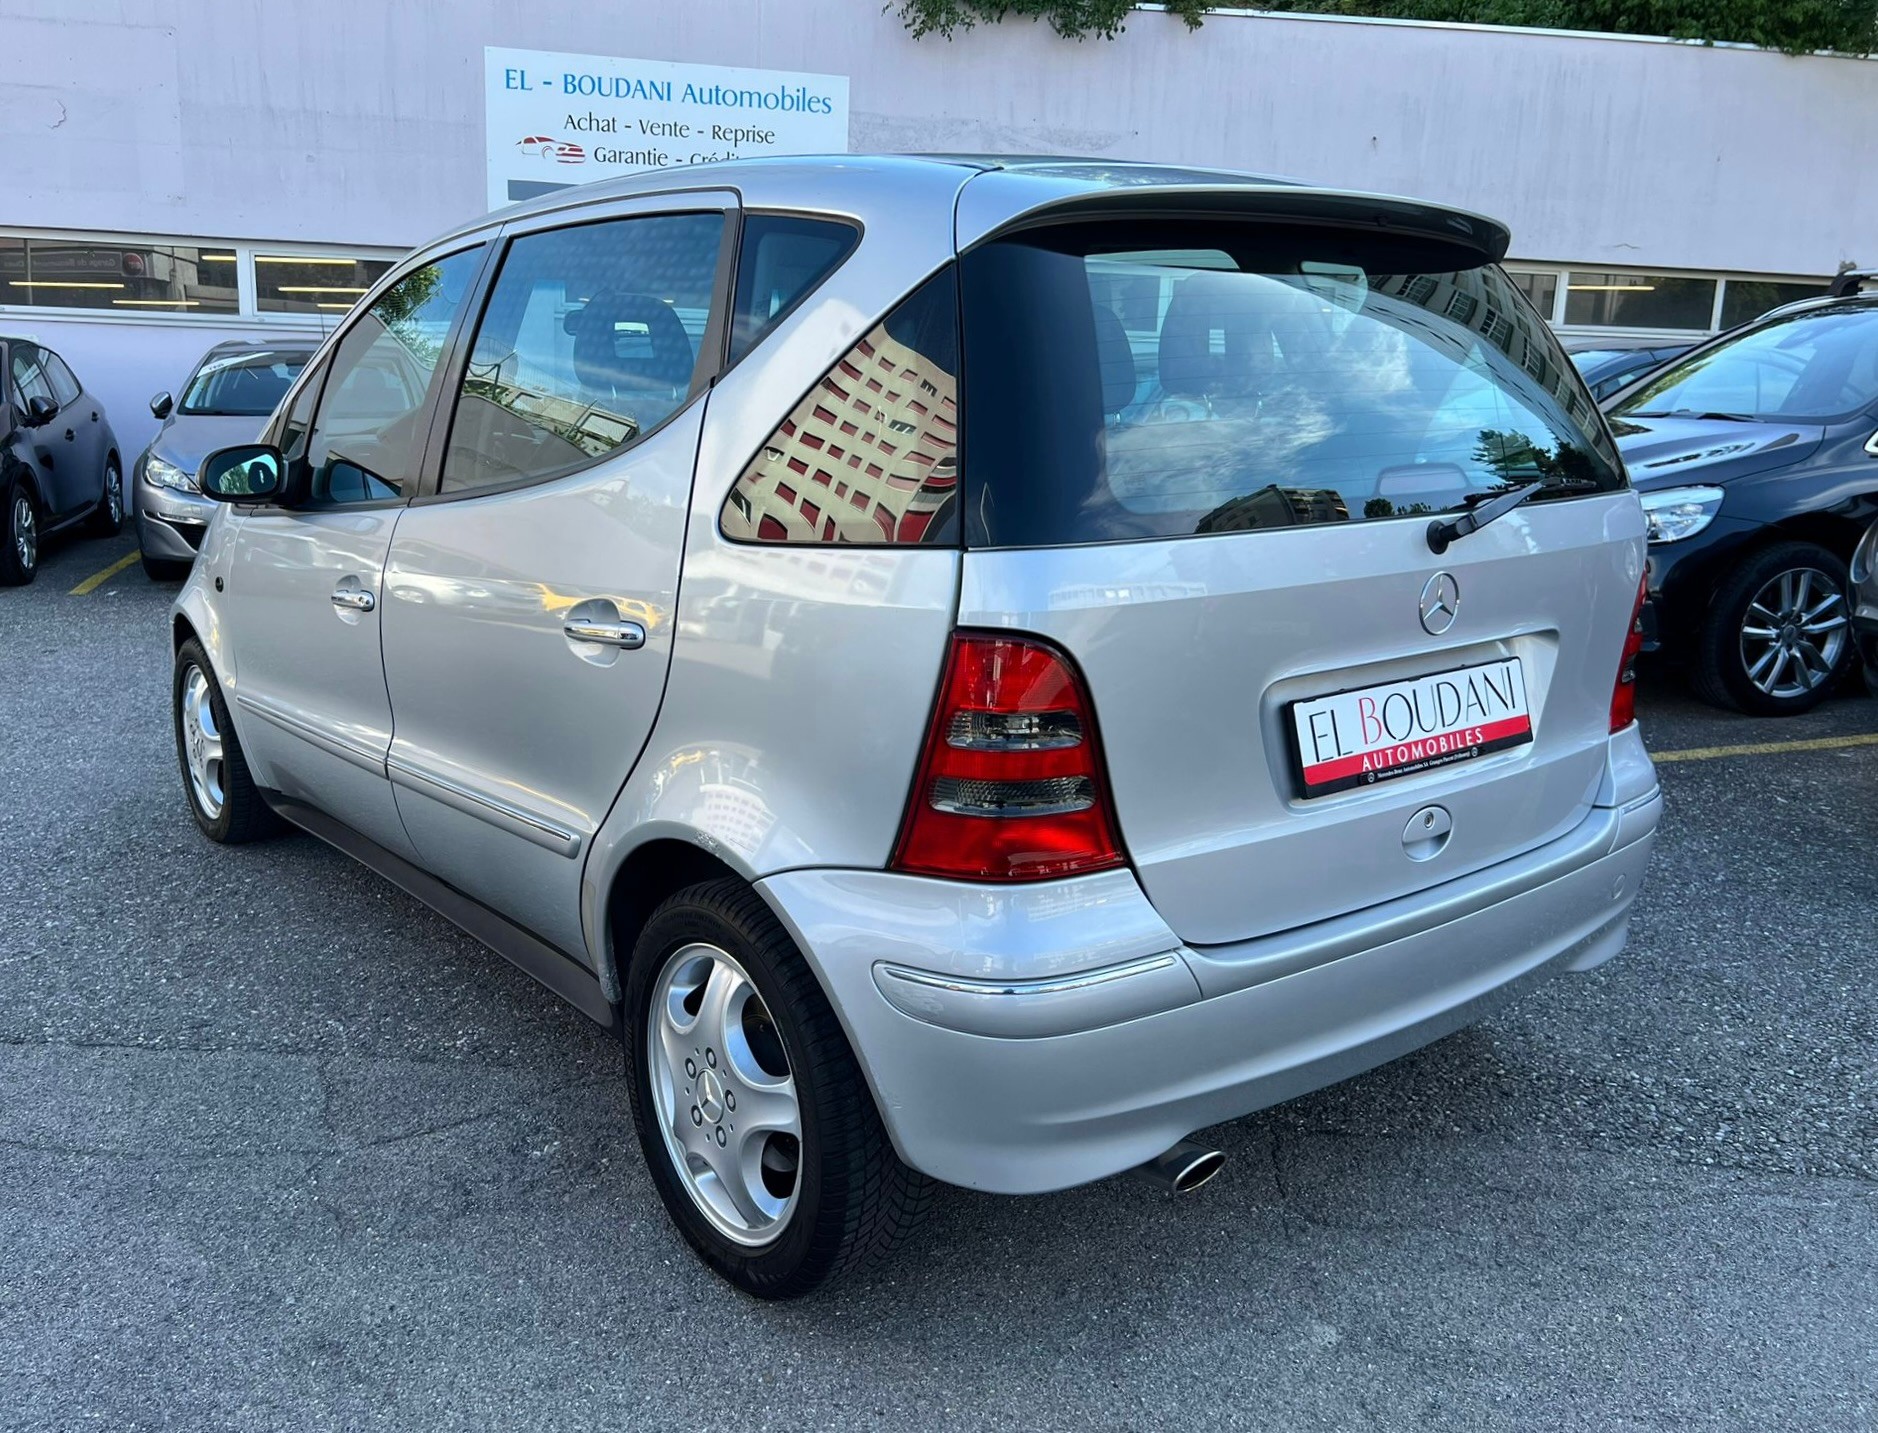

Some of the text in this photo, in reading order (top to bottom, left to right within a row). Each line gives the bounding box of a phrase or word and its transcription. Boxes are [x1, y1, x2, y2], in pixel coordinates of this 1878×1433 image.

[505, 68, 533, 91] EL
[563, 73, 673, 102] BOUDANI
[681, 83, 833, 115] Automobiles
[564, 112, 617, 133] Achat
[638, 119, 690, 139] Vente
[711, 124, 776, 148] Reprise
[594, 146, 669, 167] Garantie
[1308, 666, 1516, 763] EL BOUDANI
[1361, 727, 1484, 773] AUTOMOBILES
